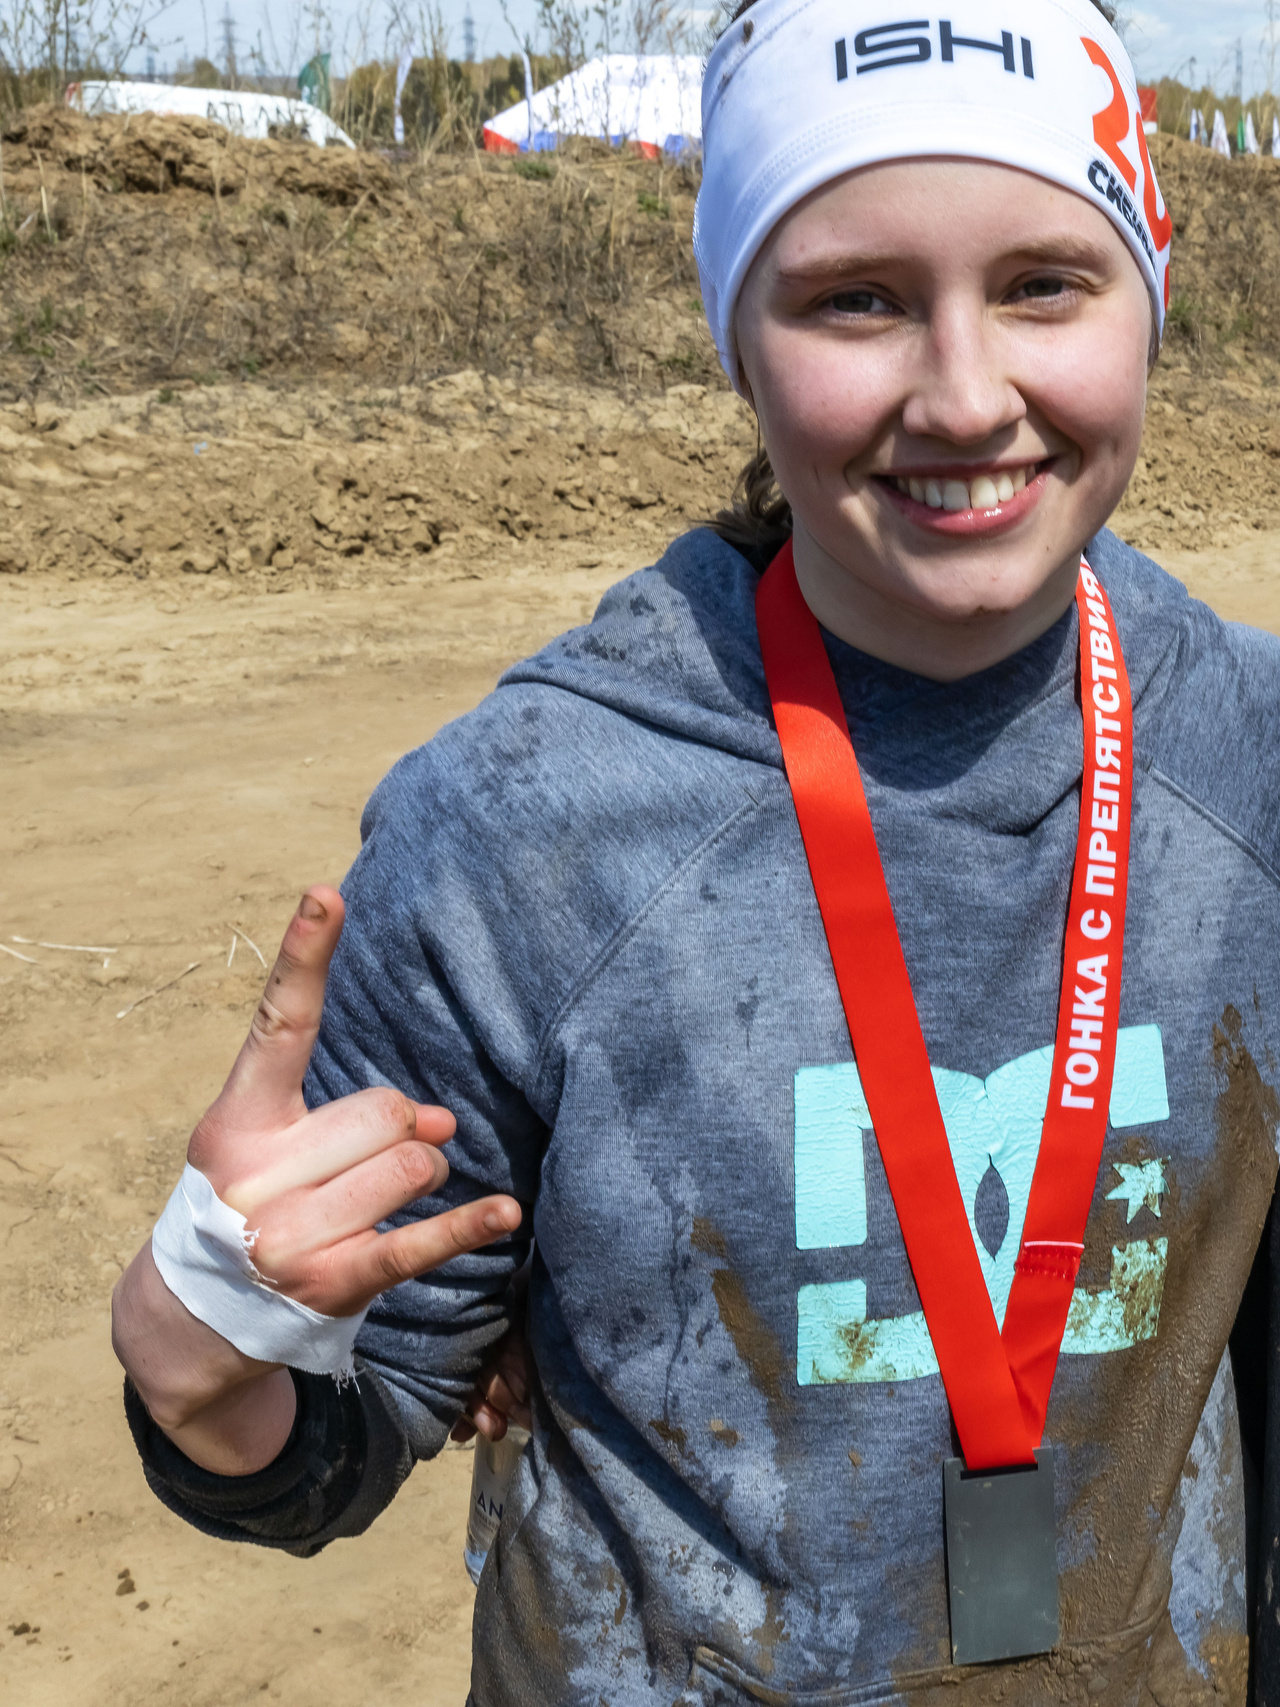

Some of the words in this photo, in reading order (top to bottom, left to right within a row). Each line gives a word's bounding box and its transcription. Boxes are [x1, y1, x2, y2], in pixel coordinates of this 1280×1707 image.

[835, 20, 1035, 82] ISHI
[1080, 554, 1122, 896] ПРЕПЯТСТВИЯ
[1081, 909, 1111, 940] С
[1061, 954, 1109, 1110] ГОНКА
